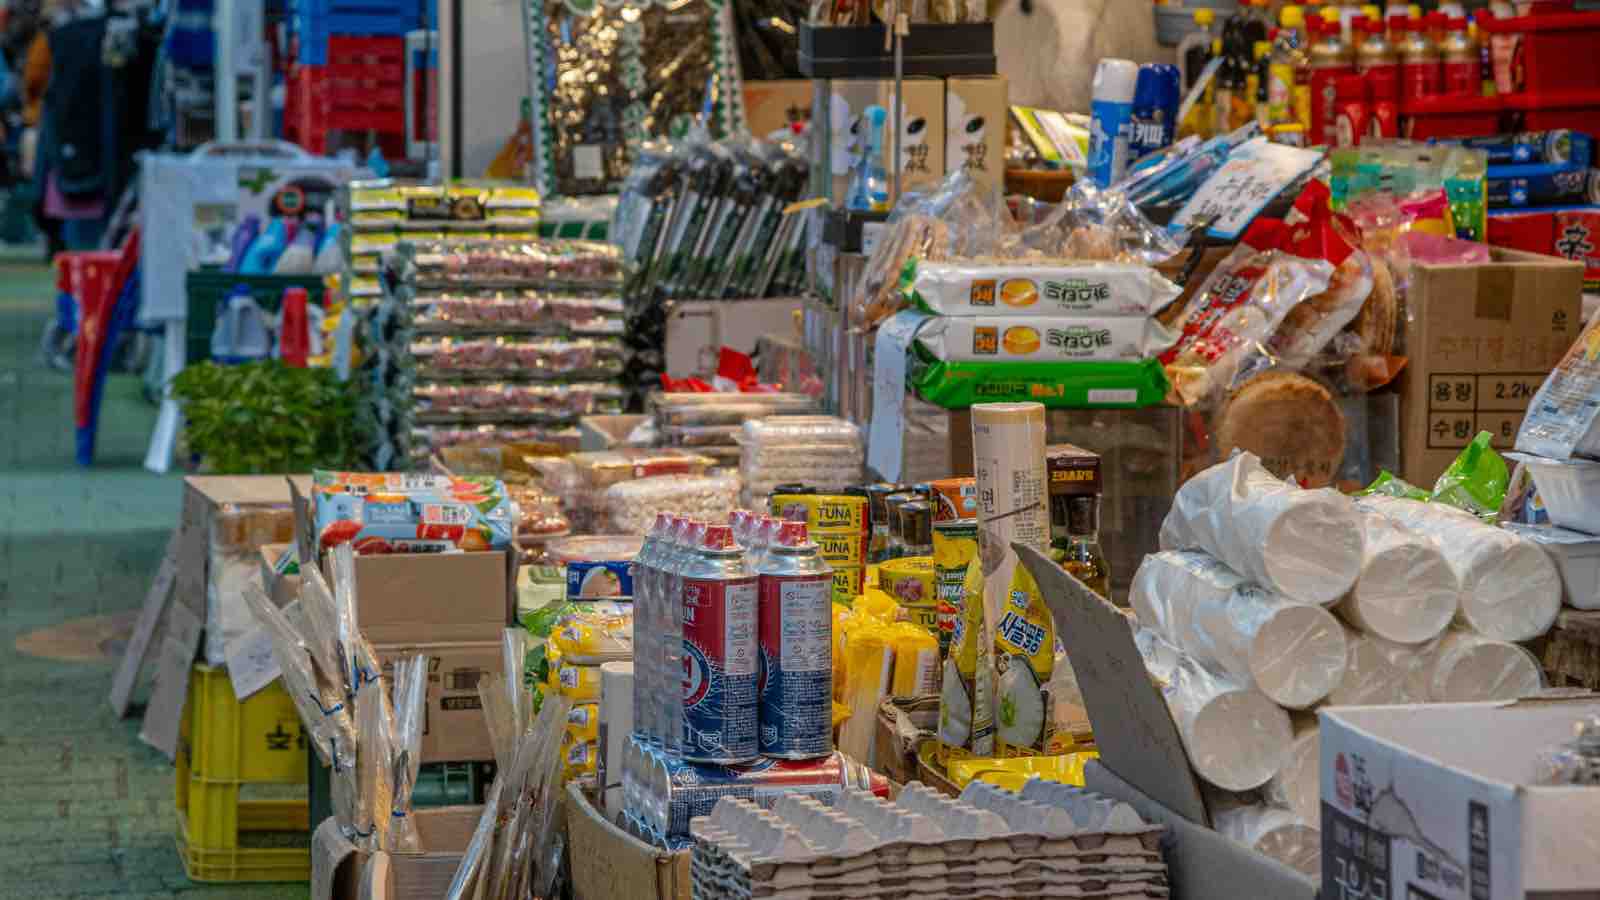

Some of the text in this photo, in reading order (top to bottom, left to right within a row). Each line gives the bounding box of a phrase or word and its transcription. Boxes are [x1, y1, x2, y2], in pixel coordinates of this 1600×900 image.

[1434, 381, 1472, 402] 용량
[1431, 421, 1471, 440] 수량
[816, 507, 851, 520] TUNA
[832, 574, 850, 586] NA
[918, 612, 937, 626] TU
